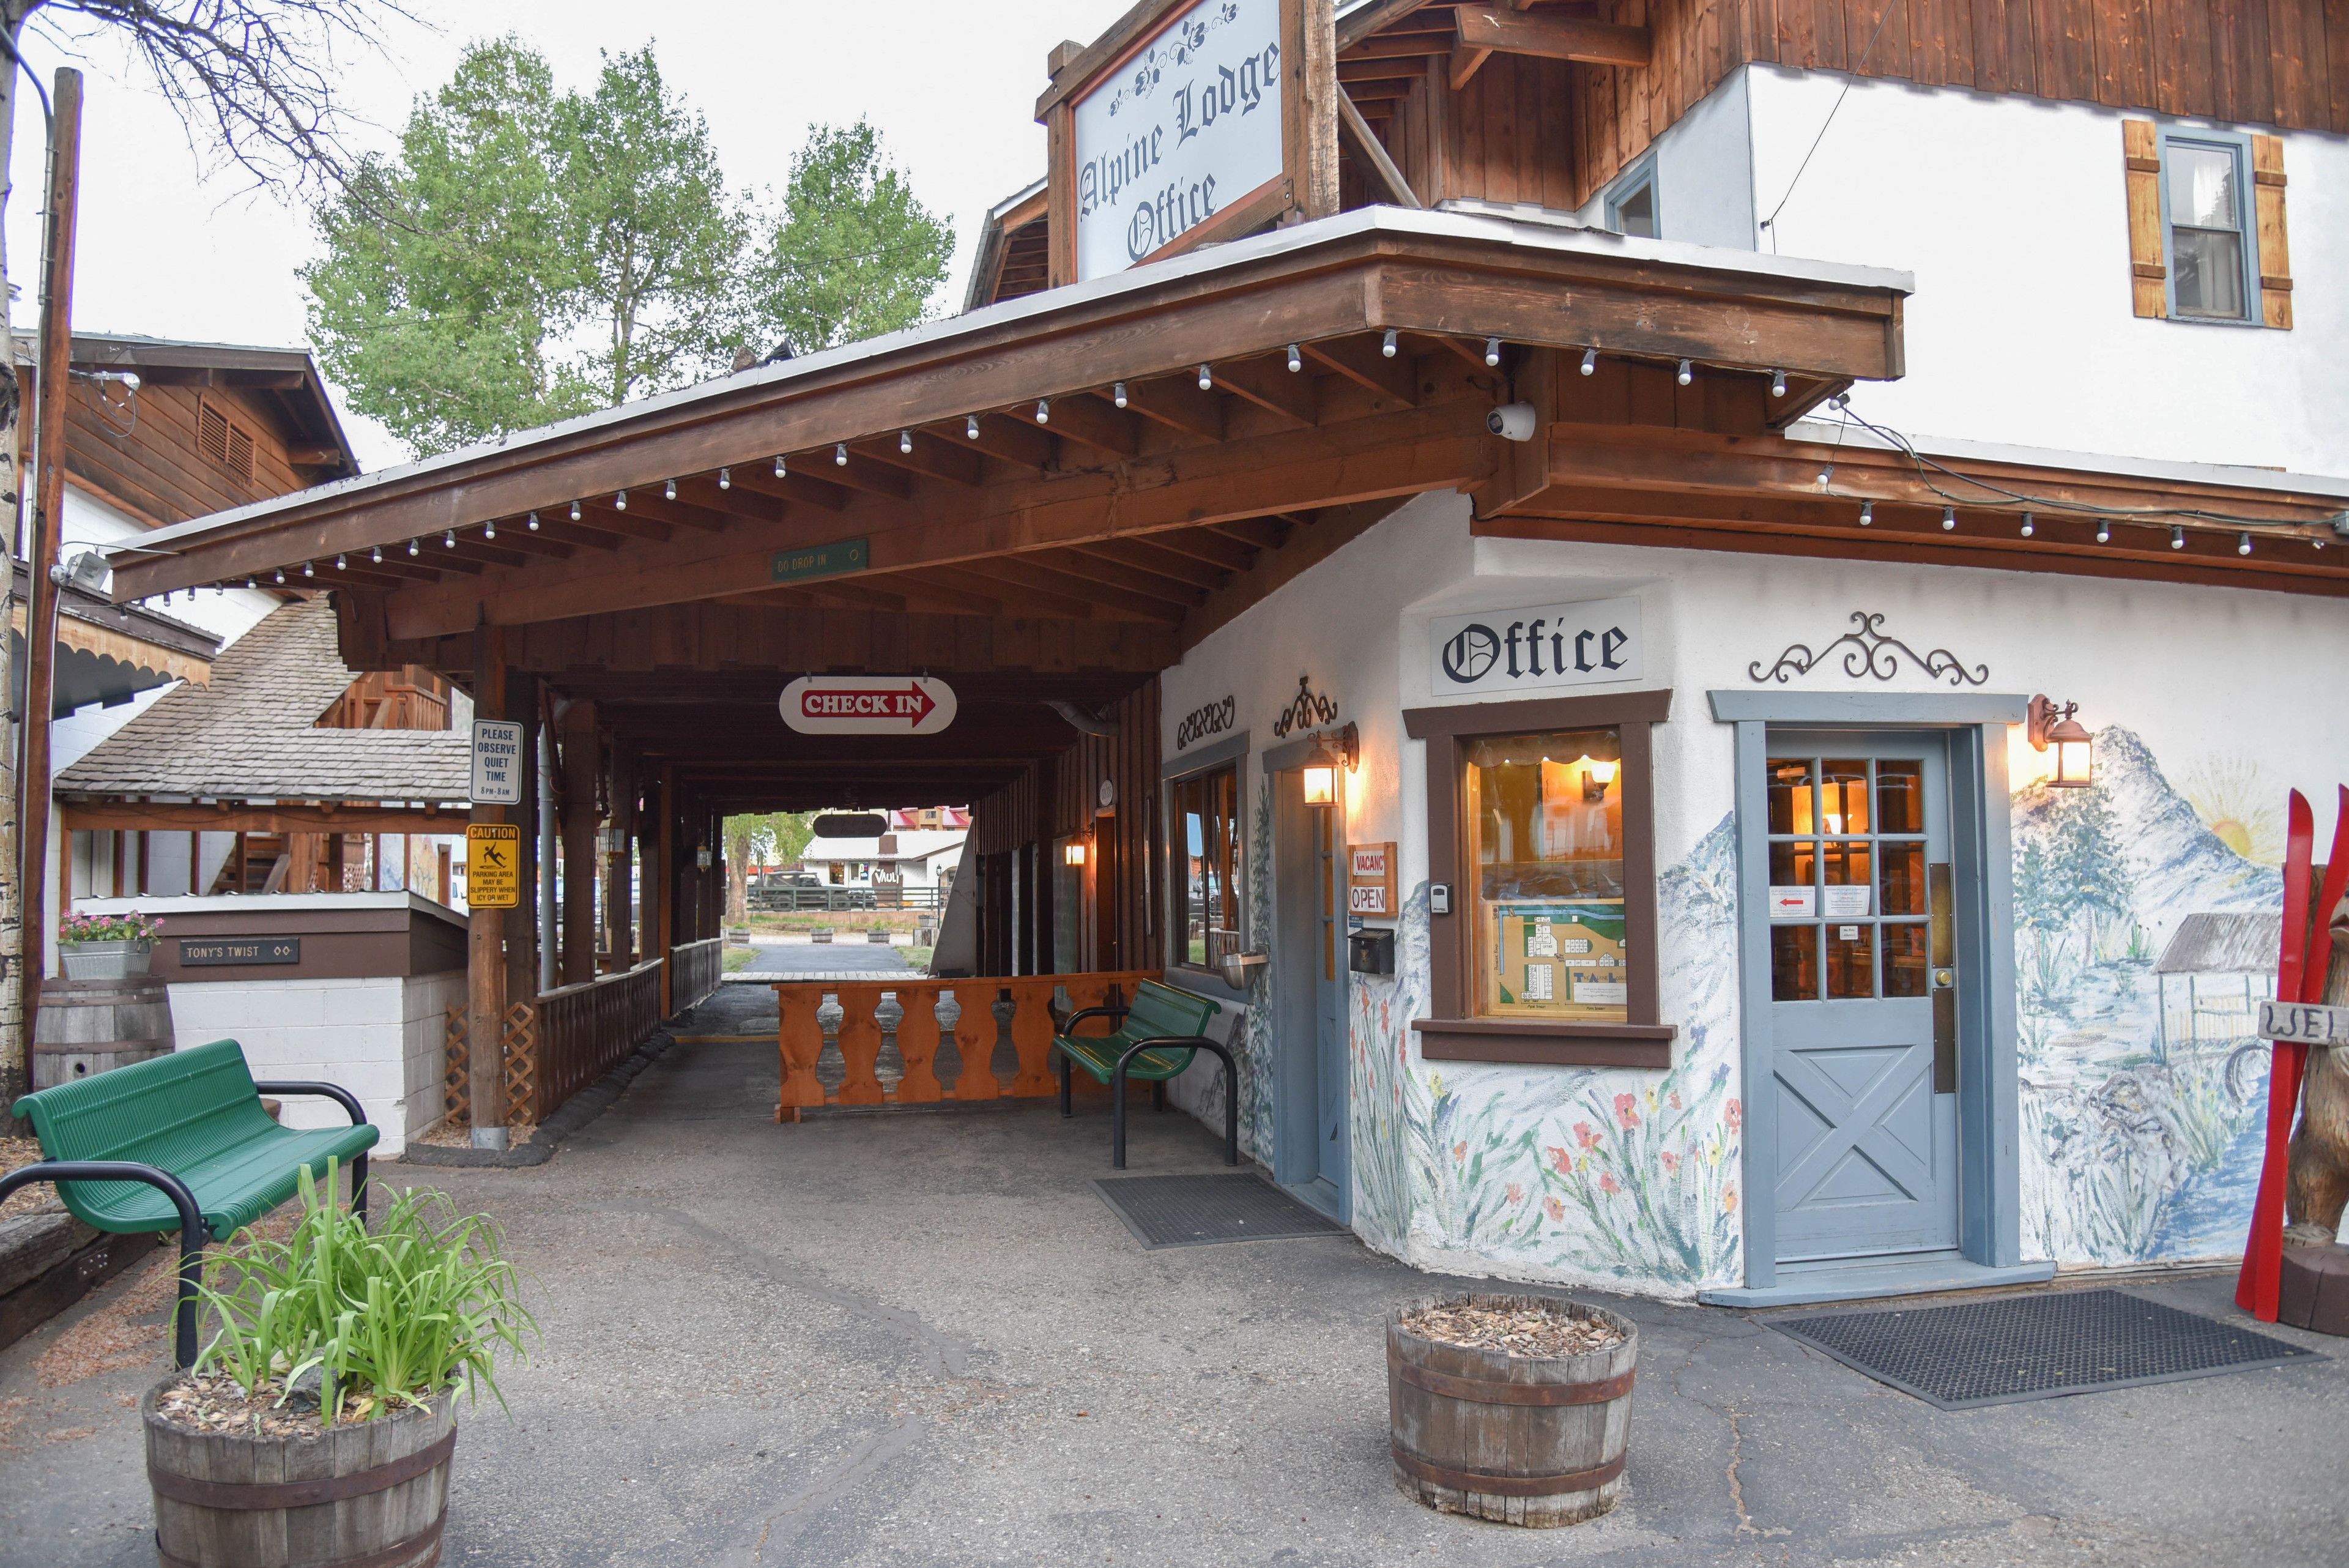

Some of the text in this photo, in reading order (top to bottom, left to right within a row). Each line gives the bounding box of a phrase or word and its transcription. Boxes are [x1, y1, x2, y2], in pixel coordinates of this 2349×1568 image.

[1080, 42, 1280, 222] Alpine Lodge
[1127, 173, 1217, 262] Office
[792, 556, 814, 570] DROP
[818, 554, 826, 568] IN
[1442, 617, 1629, 683] Office
[805, 695, 924, 713] CHECK IN
[481, 729, 513, 740] PLEASE
[478, 743, 516, 754] OBSERVE
[484, 757, 509, 768] QUIET
[486, 771, 507, 782] TIME
[470, 827, 516, 839] CAUTION
[1352, 888, 1385, 908] OPEN
[187, 946, 259, 958] TONY'S TWIST
[2266, 1005, 2349, 1038] WEL
